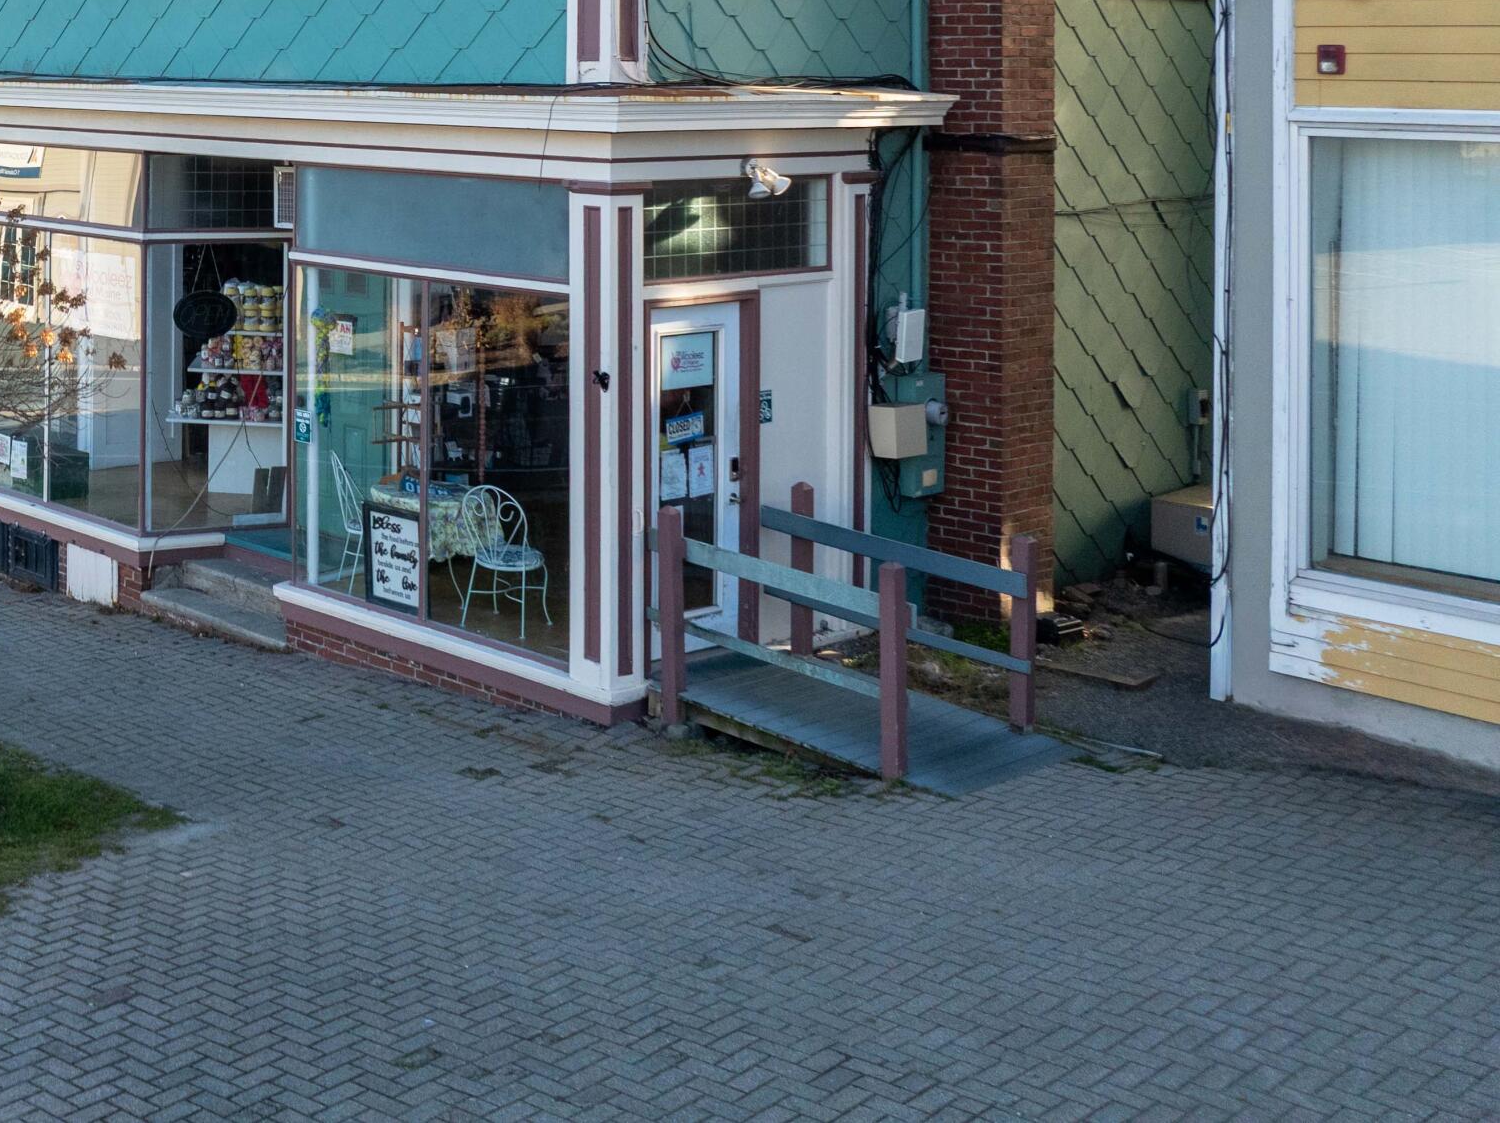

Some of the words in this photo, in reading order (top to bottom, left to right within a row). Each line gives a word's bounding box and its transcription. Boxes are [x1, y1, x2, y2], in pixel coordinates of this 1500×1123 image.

[668, 418, 692, 435] CLOSED
[372, 515, 402, 534] Bless
[374, 541, 389, 556] the
[390, 544, 418, 569] family
[401, 565, 412, 574] and
[376, 568, 390, 584] the
[402, 576, 418, 592] love
[383, 586, 404, 598] between
